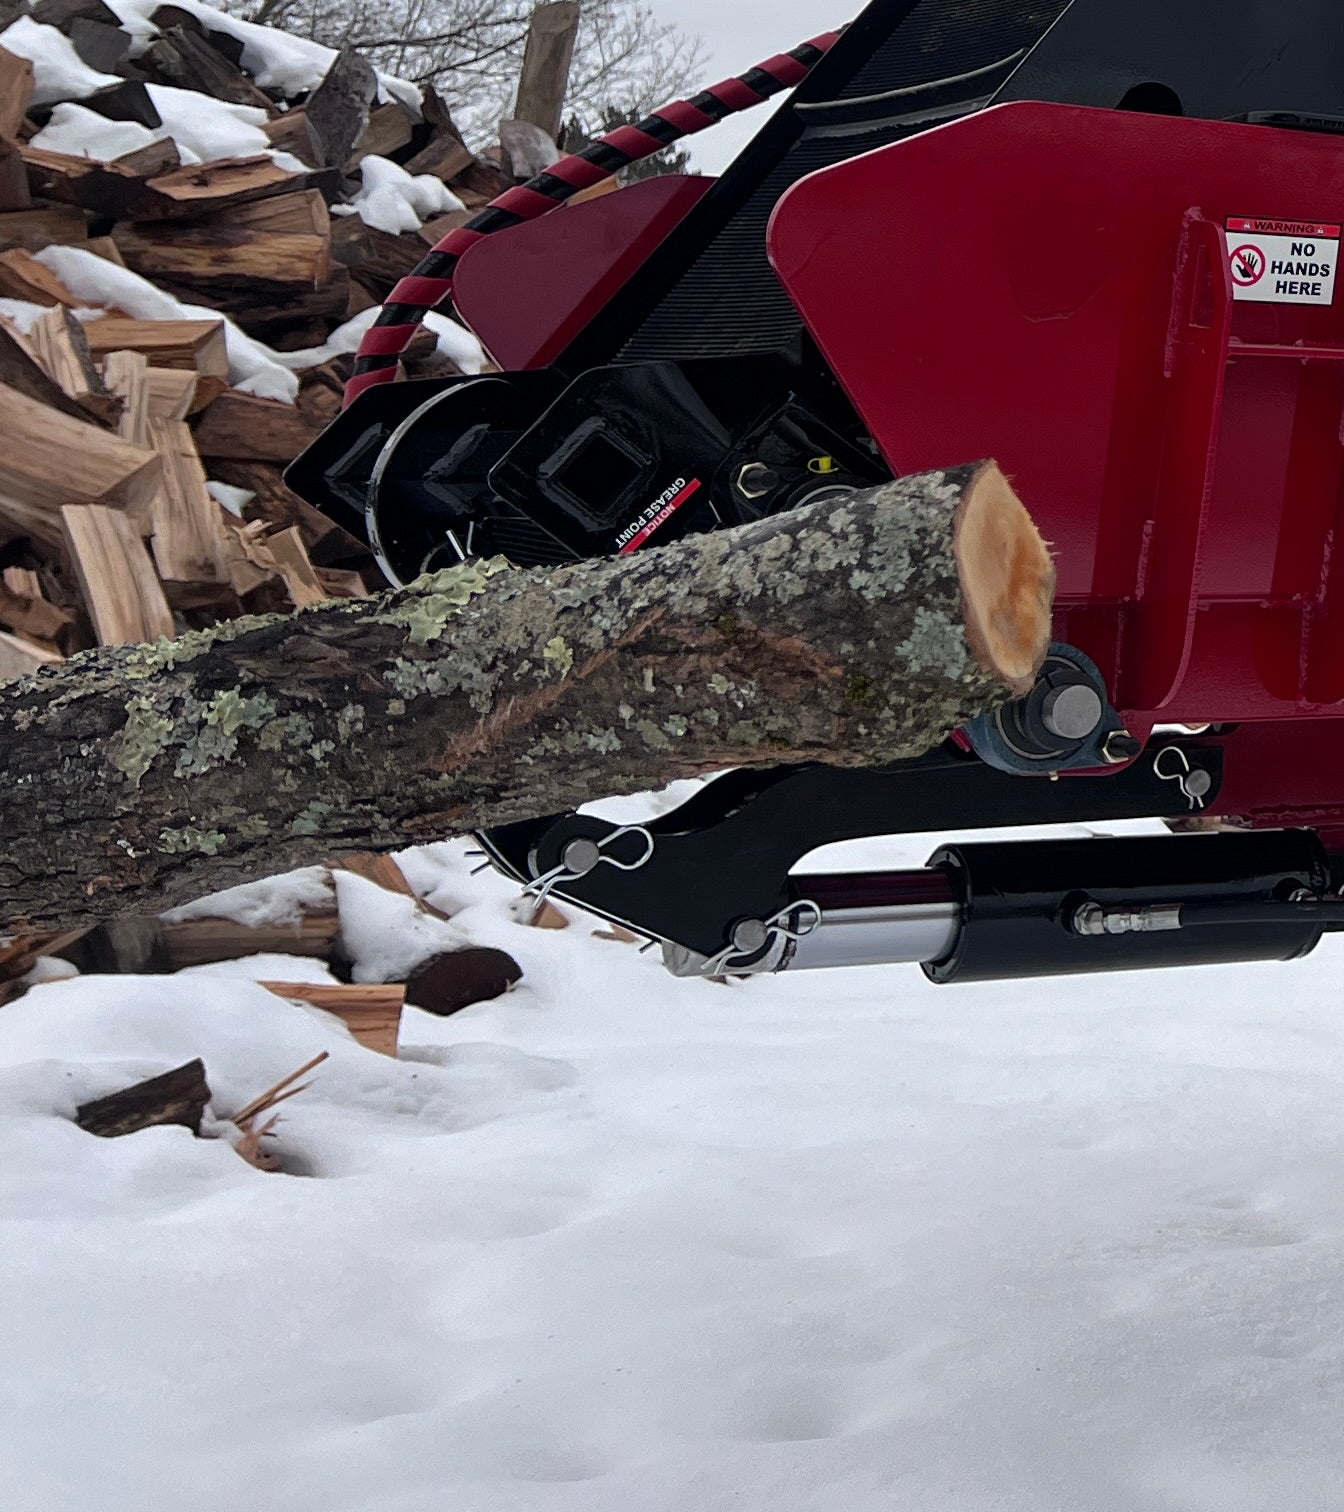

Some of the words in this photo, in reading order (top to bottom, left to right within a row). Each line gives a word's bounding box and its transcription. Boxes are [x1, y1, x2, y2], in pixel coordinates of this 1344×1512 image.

[1254, 221, 1315, 234] WARNING
[1291, 243, 1316, 257] NO
[1271, 261, 1330, 277] HANDS
[1275, 281, 1322, 296] HERE
[643, 477, 686, 519] GREASE
[615, 515, 647, 549] POINT
